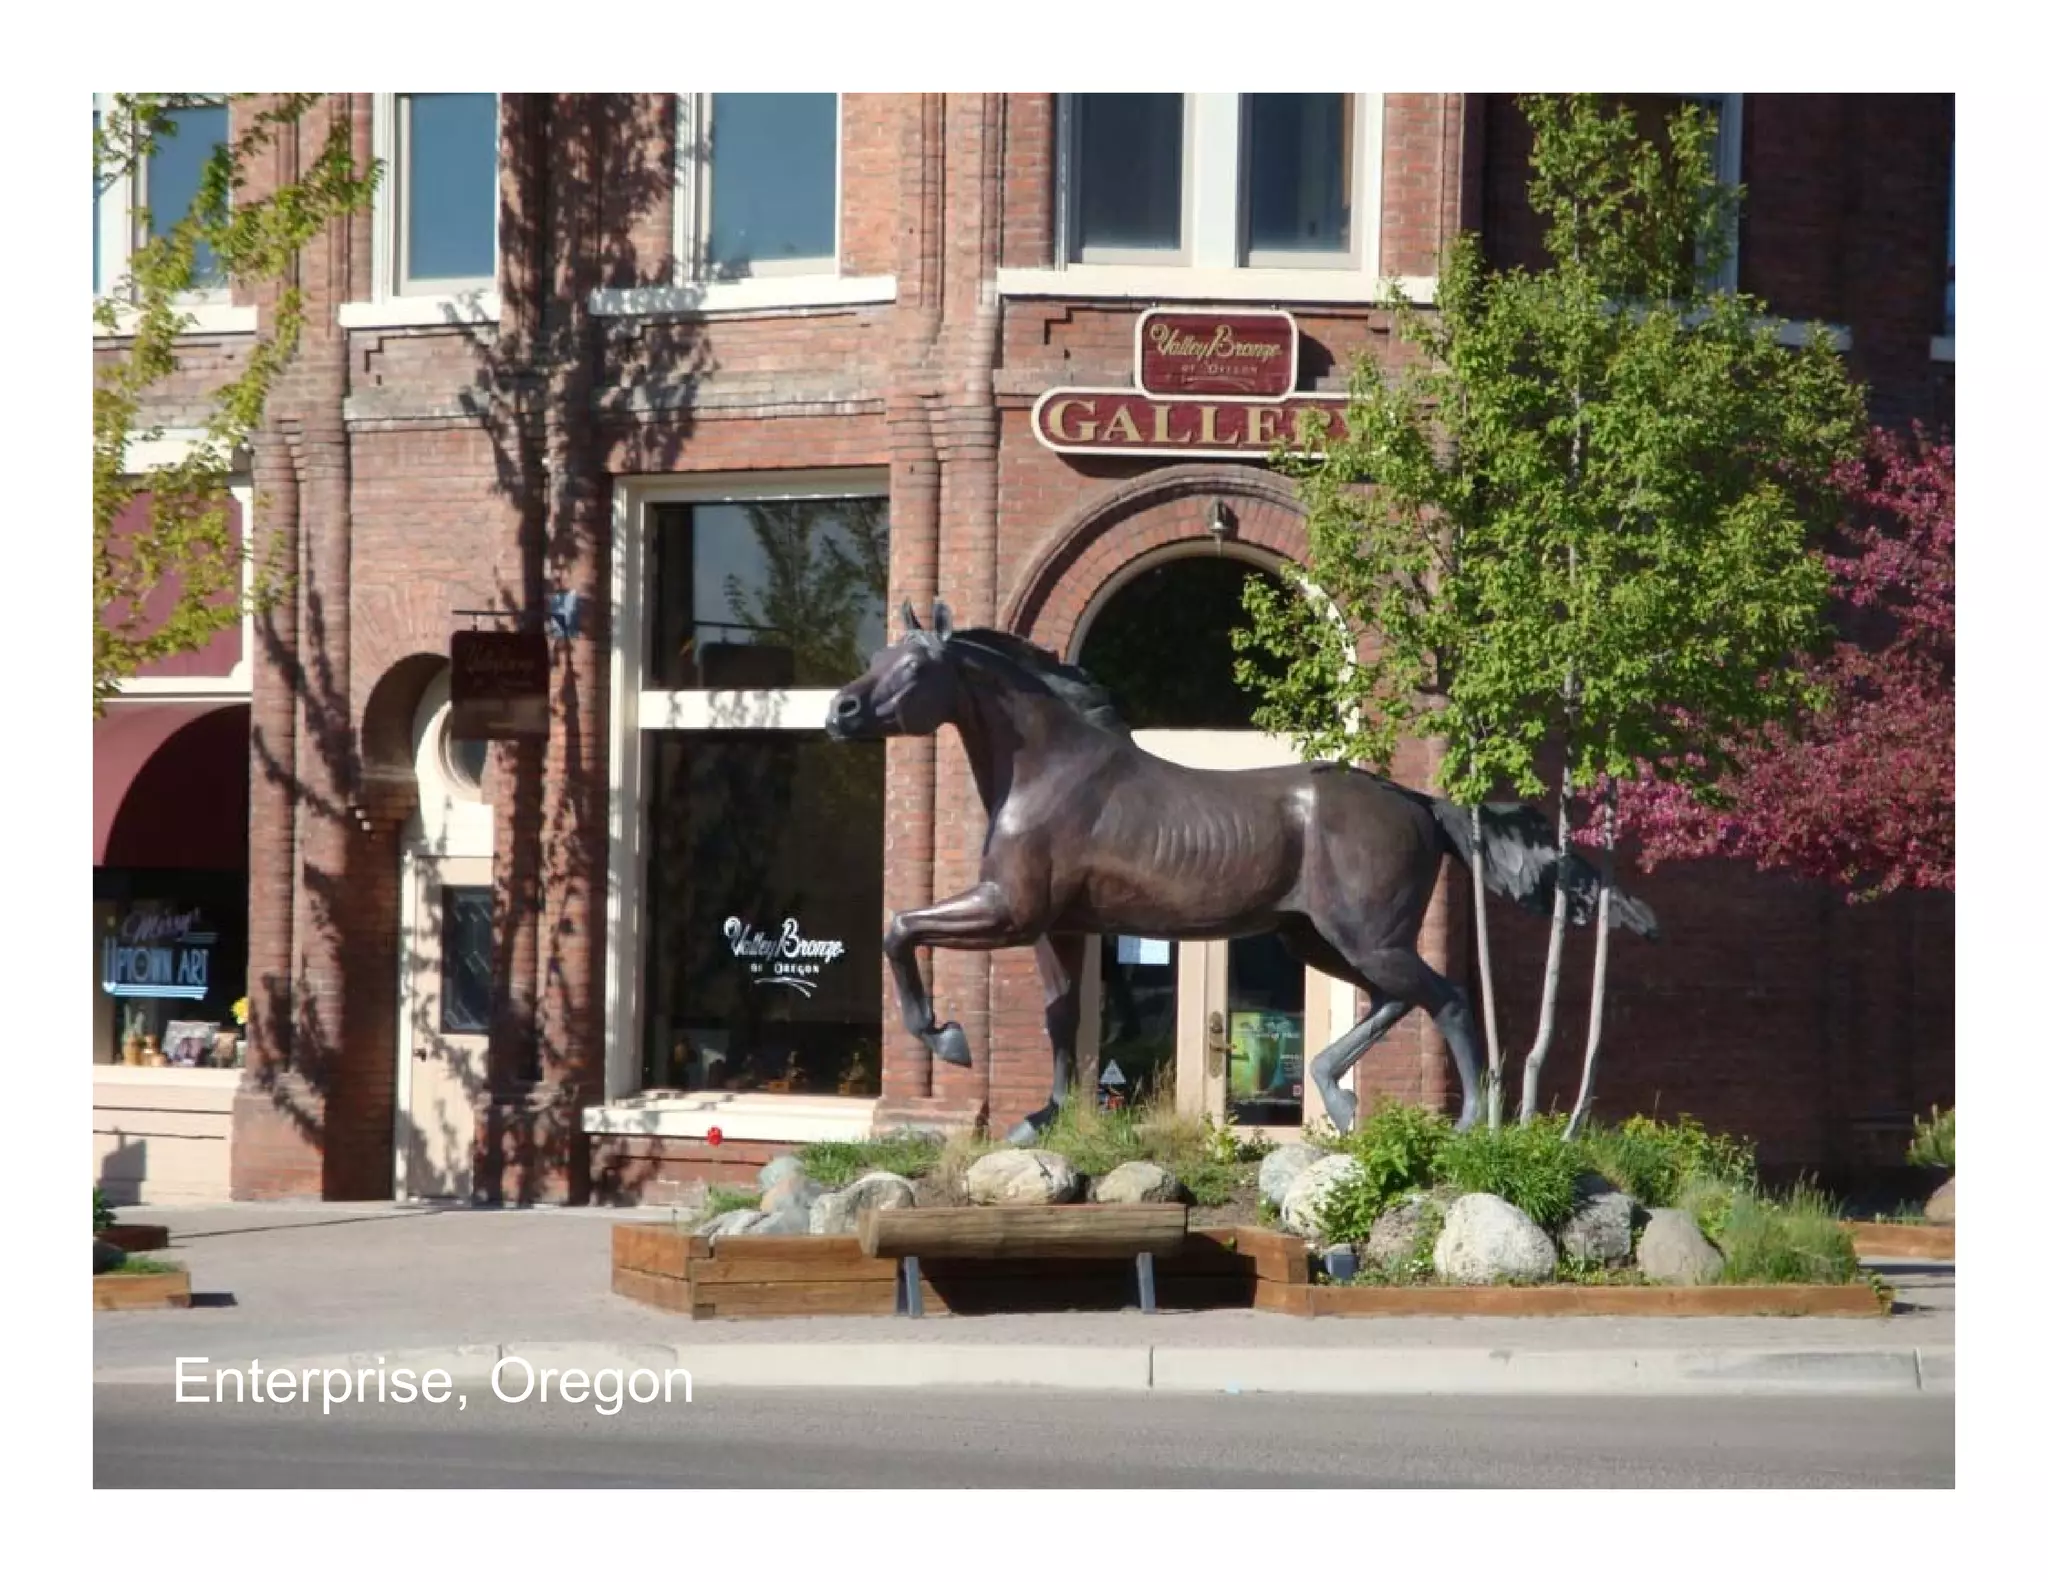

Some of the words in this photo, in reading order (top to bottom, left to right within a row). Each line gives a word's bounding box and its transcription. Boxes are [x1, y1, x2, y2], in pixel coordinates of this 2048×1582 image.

[1150, 323, 1209, 361] Valley
[1206, 324, 1282, 362] Bronze
[1046, 397, 1353, 447] GALLER
[723, 915, 778, 962] Valley
[774, 917, 845, 963] Bronze
[176, 949, 210, 985] ART
